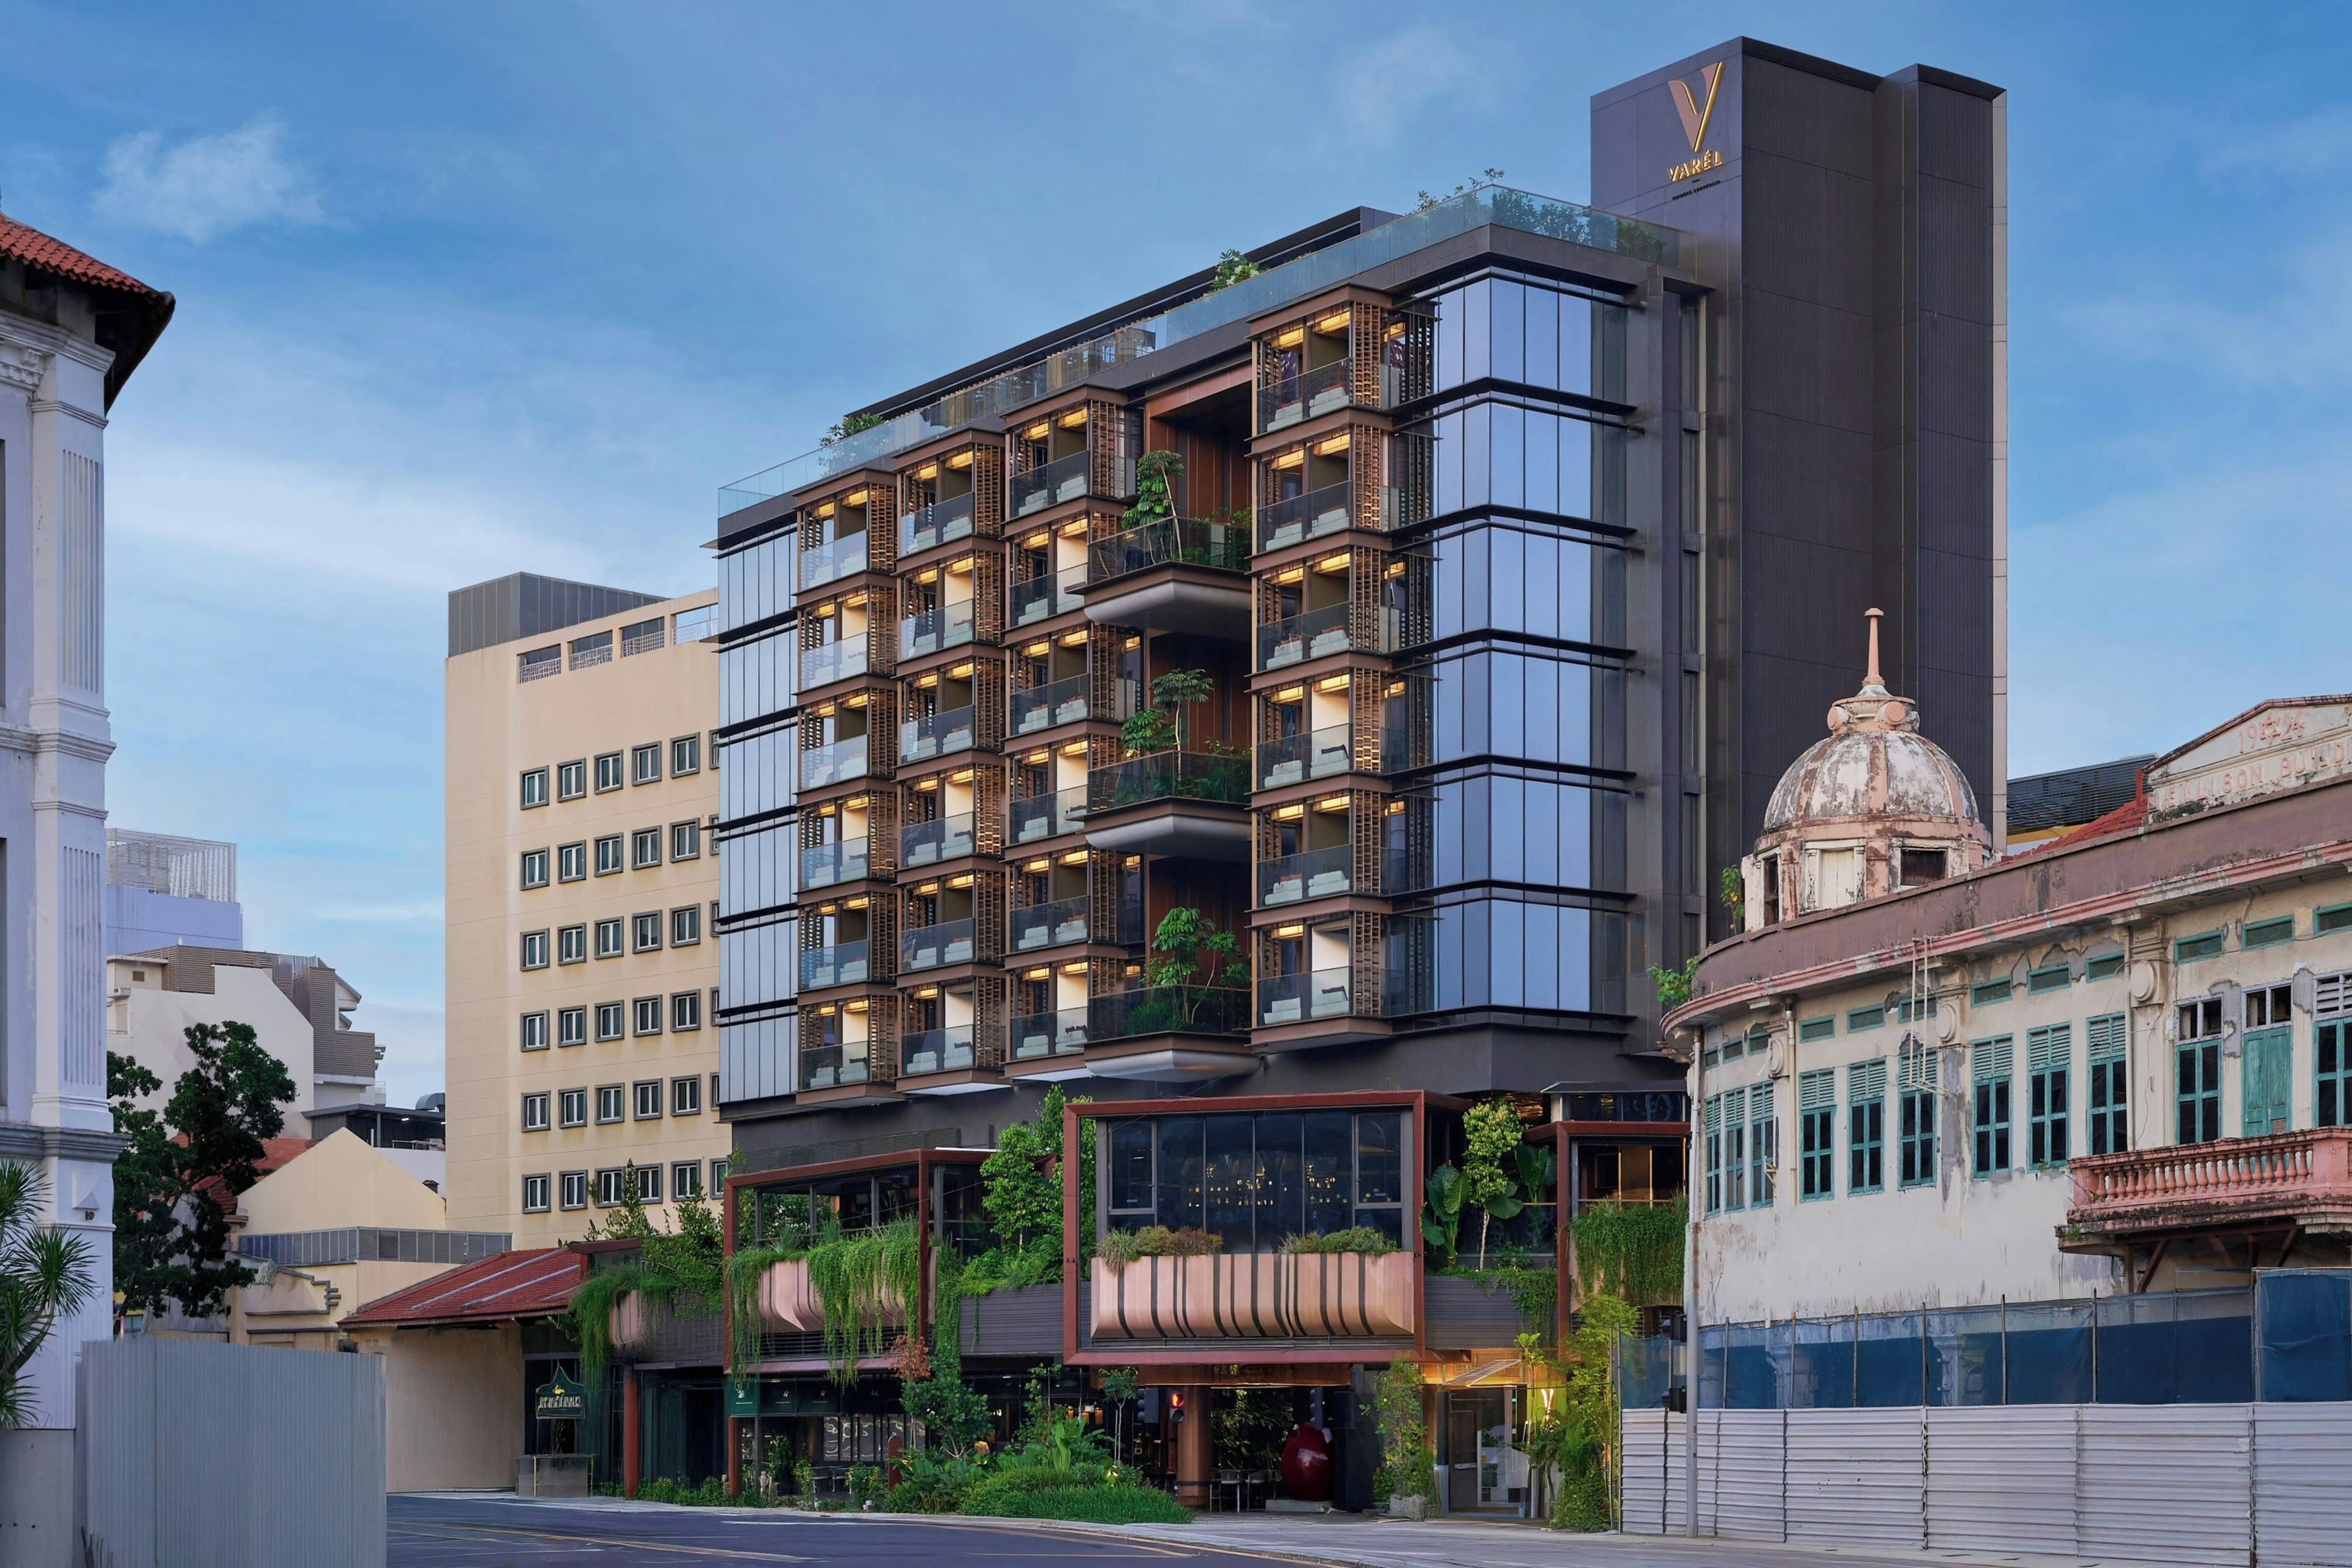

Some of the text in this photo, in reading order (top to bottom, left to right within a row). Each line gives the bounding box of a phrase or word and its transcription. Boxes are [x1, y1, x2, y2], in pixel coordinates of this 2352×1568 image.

[1667, 61, 1724, 152] V
[1667, 149, 1723, 182] VARÉL
[2167, 764, 2264, 808] ELLISON
